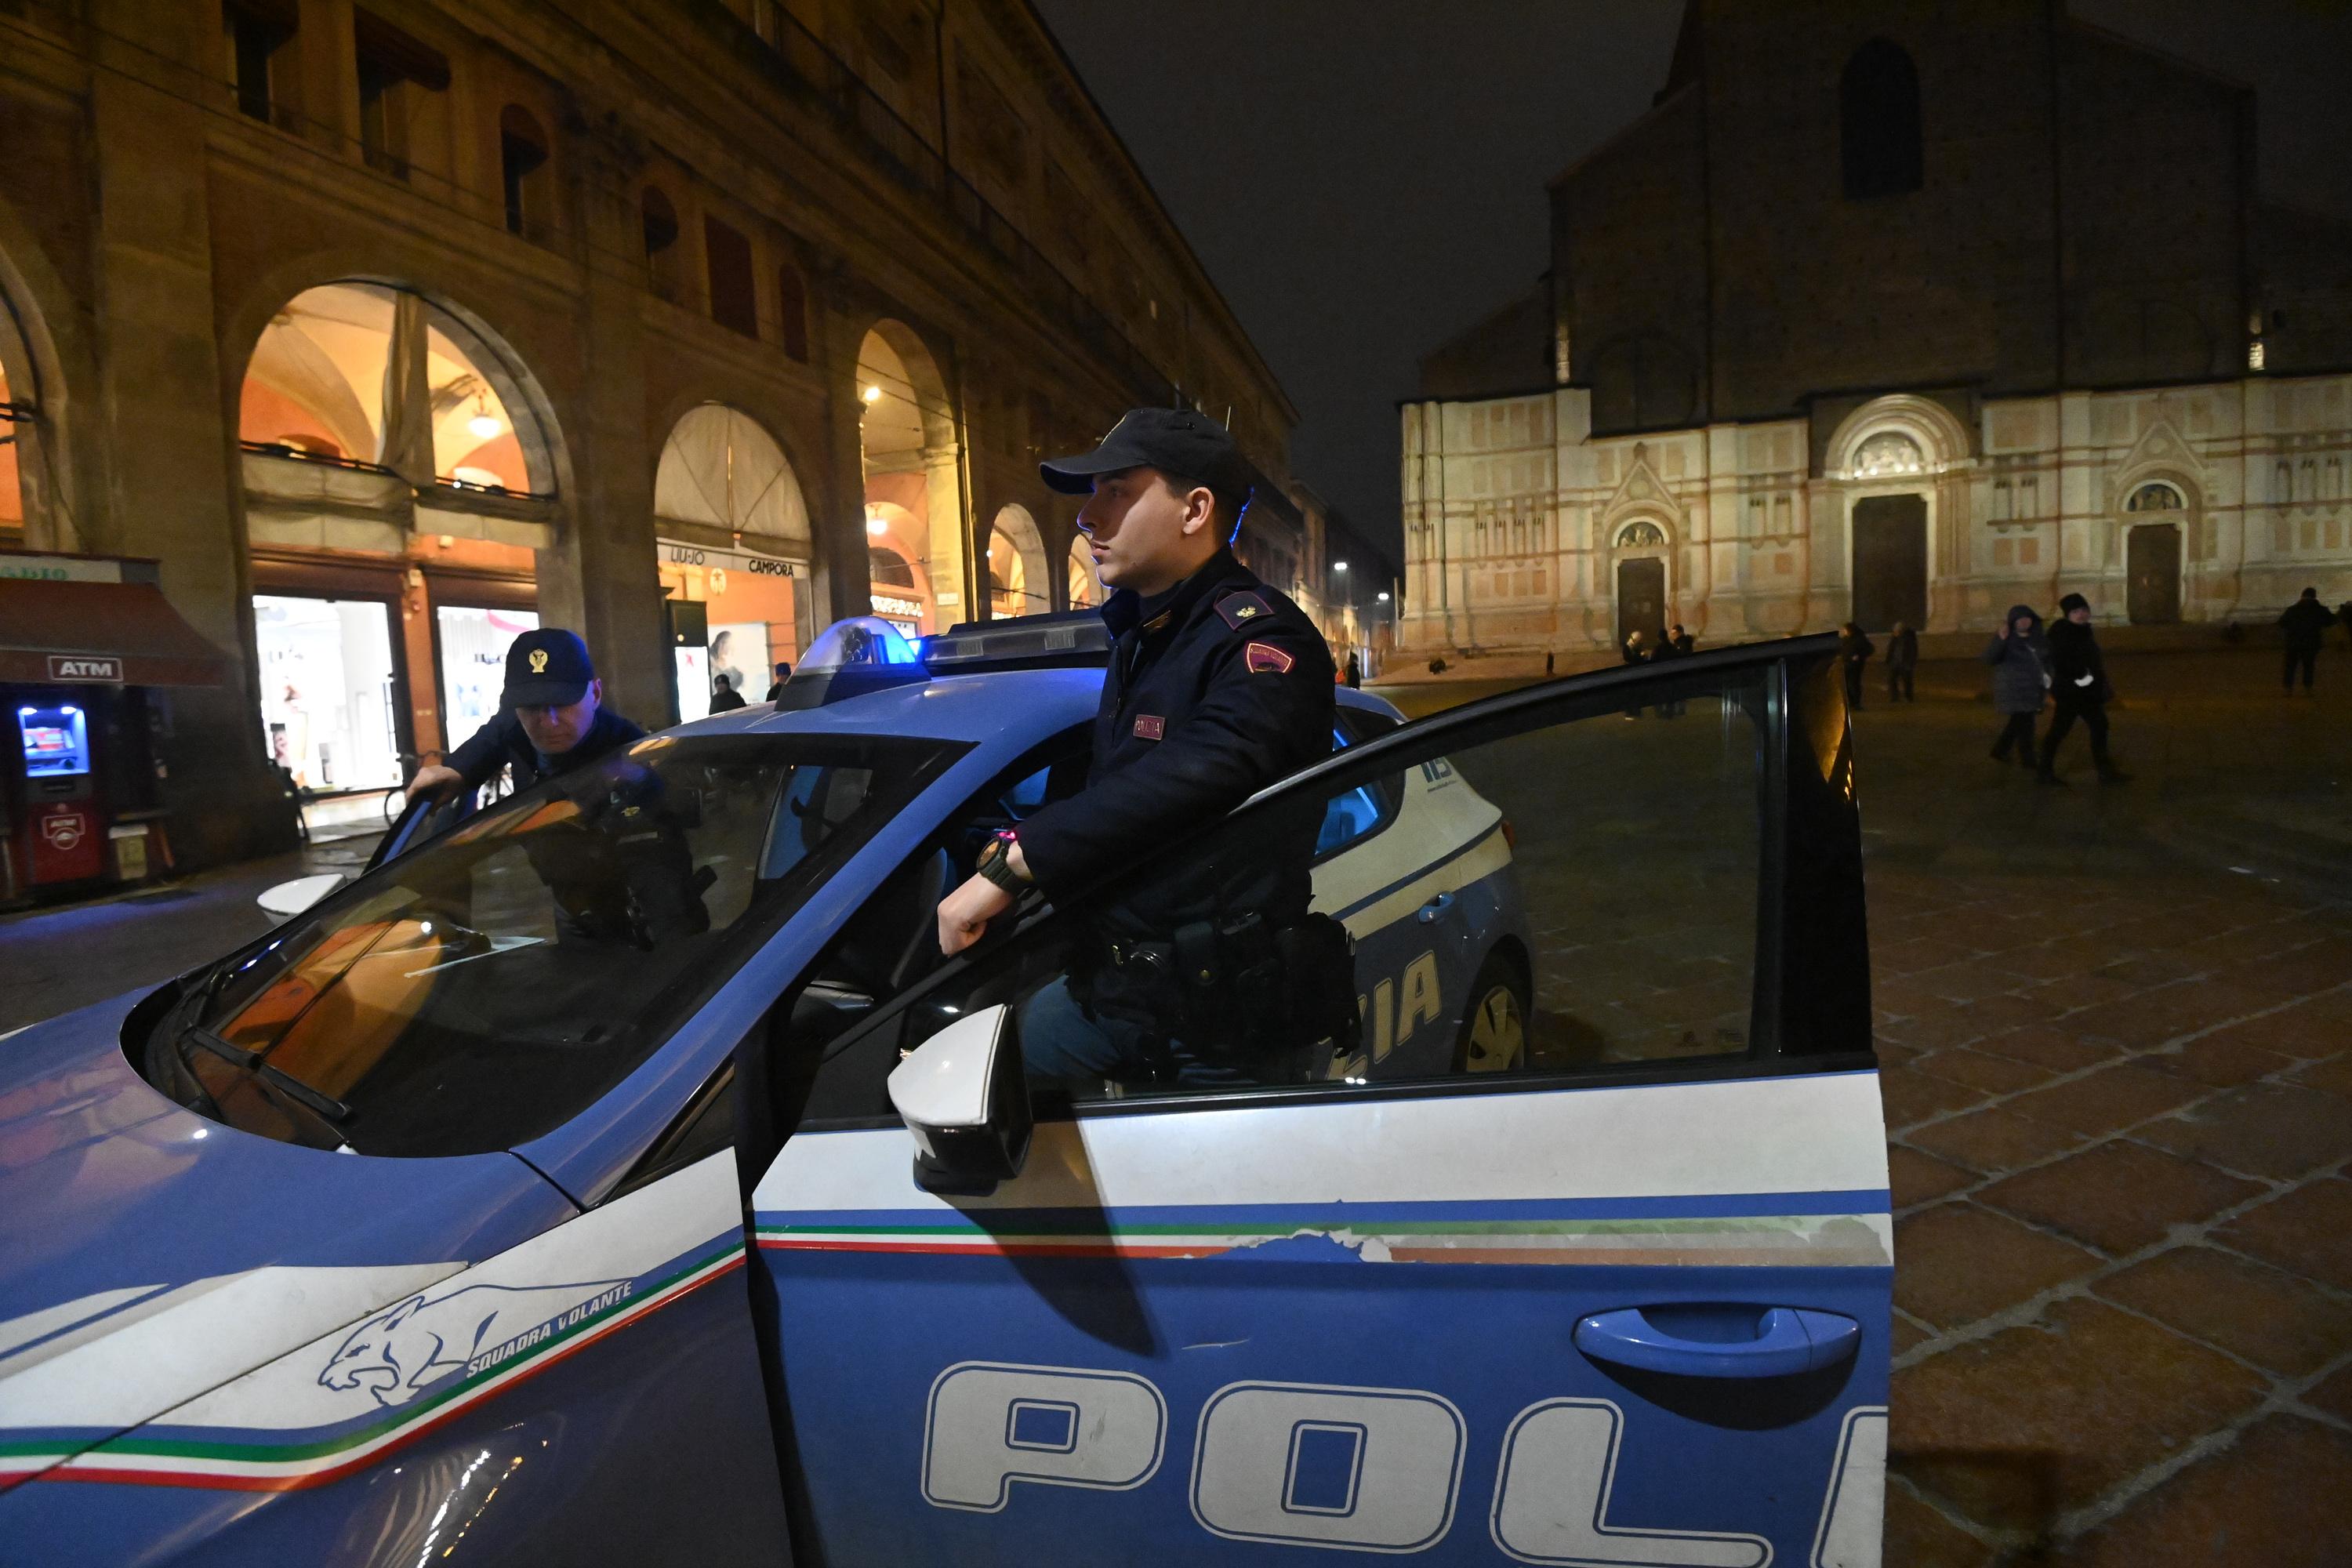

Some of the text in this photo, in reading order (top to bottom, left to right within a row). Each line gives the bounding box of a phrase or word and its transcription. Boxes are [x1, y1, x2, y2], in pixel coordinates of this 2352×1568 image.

[749, 560, 794, 577] CAMPORA
[60, 662, 112, 676] ATM
[466, 1281, 632, 1378] SQUADRA VOLANTE
[920, 1359, 1888, 1568] POLI
